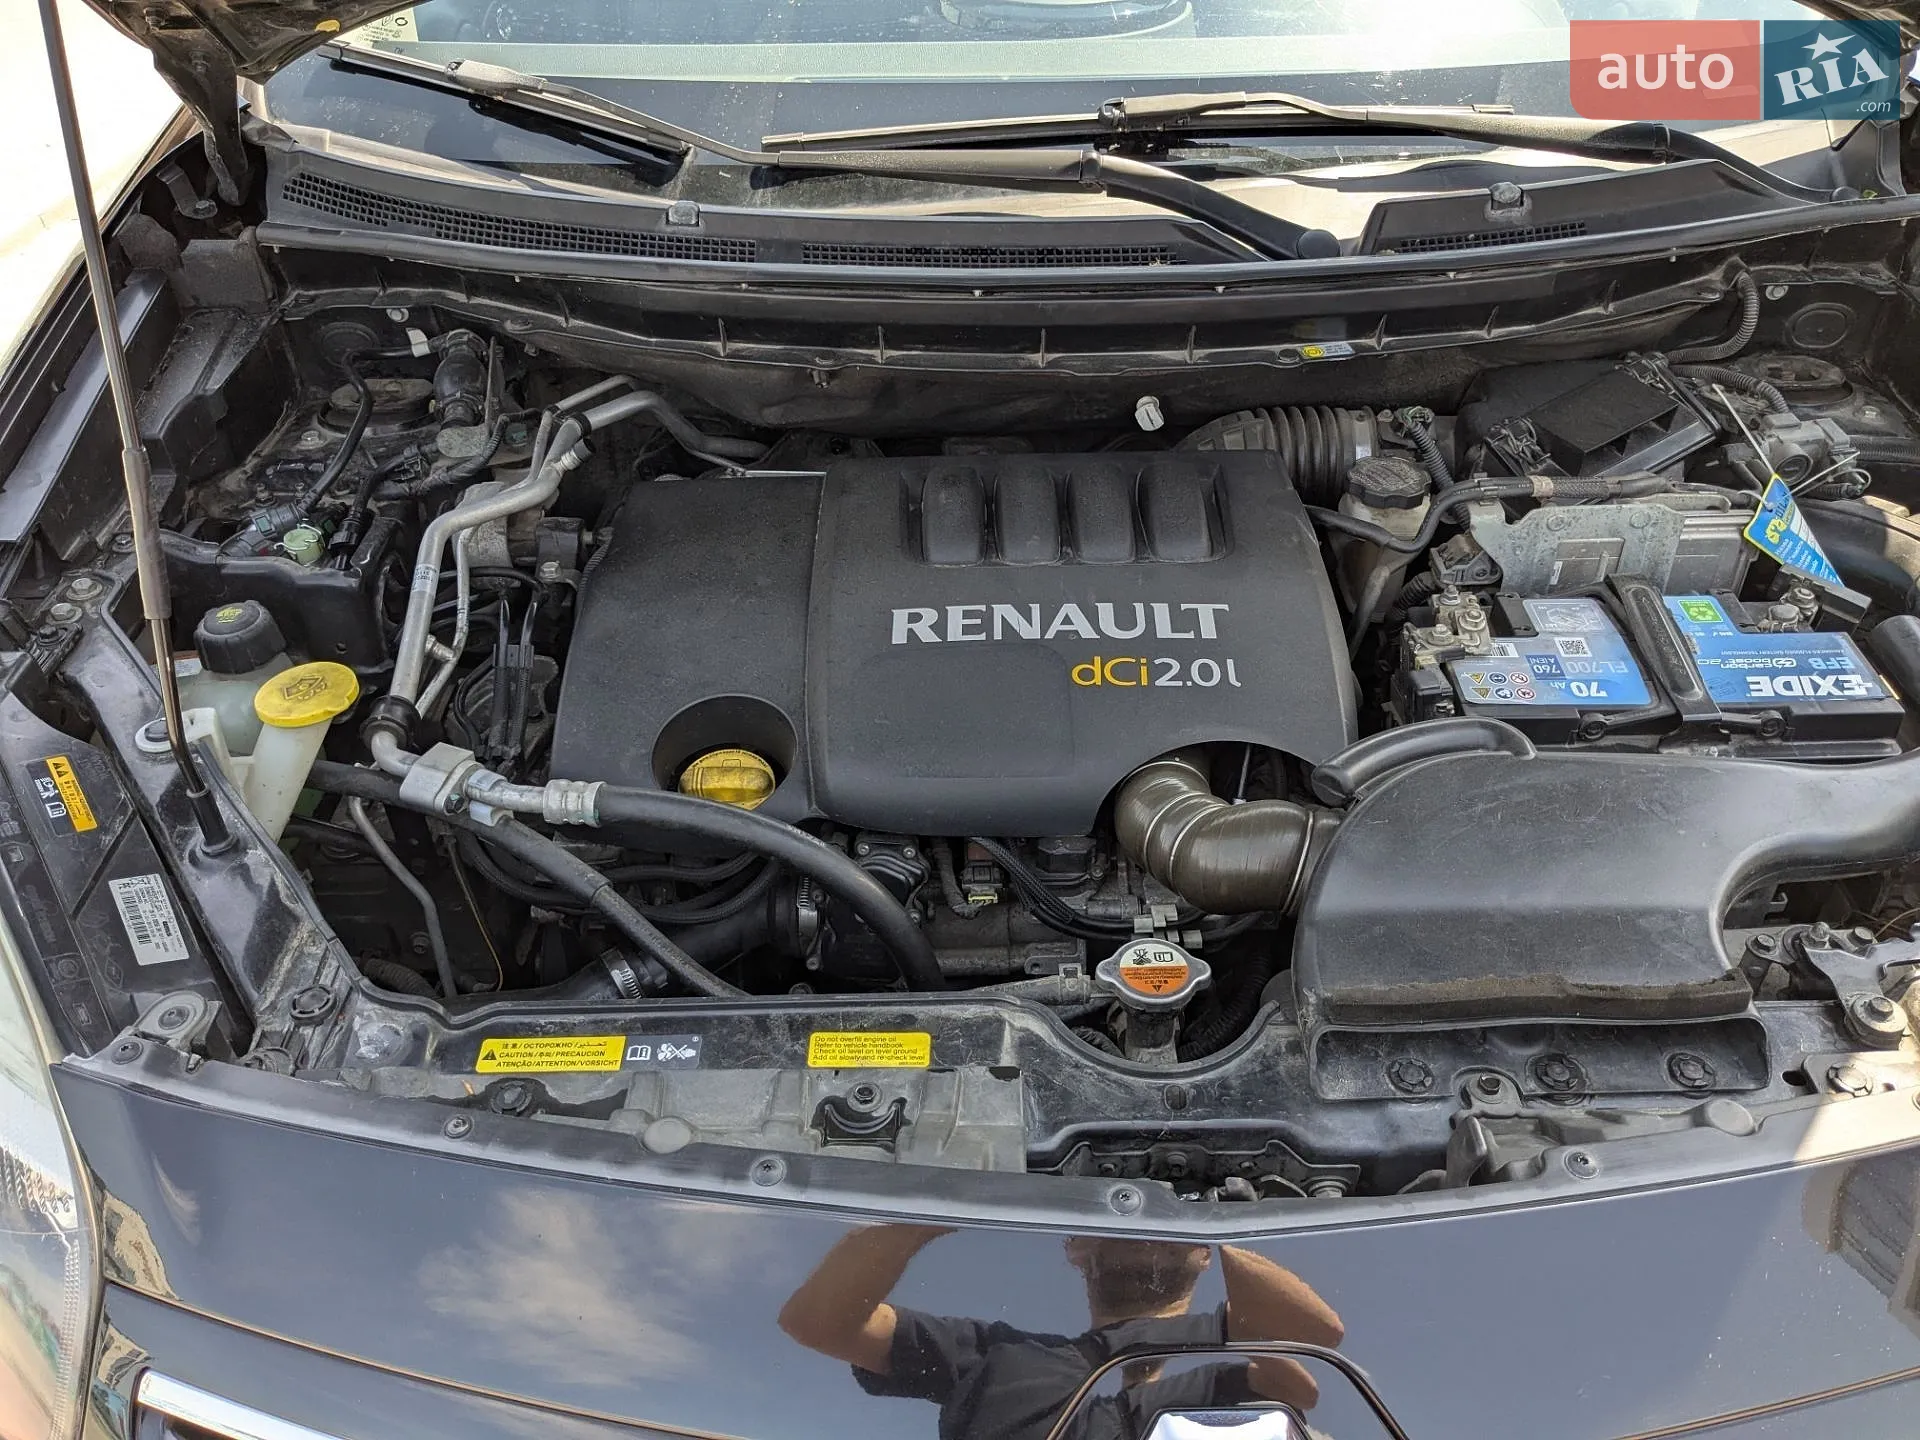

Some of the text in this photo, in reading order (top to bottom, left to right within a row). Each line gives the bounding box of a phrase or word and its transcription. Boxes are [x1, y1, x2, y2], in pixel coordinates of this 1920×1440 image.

[891, 602, 1230, 645] RENAULT
[1533, 664, 1560, 674] 760
[1808, 657, 1856, 670] EFB
[1569, 681, 1608, 697] 70
[1746, 675, 1872, 697] EXIDE
